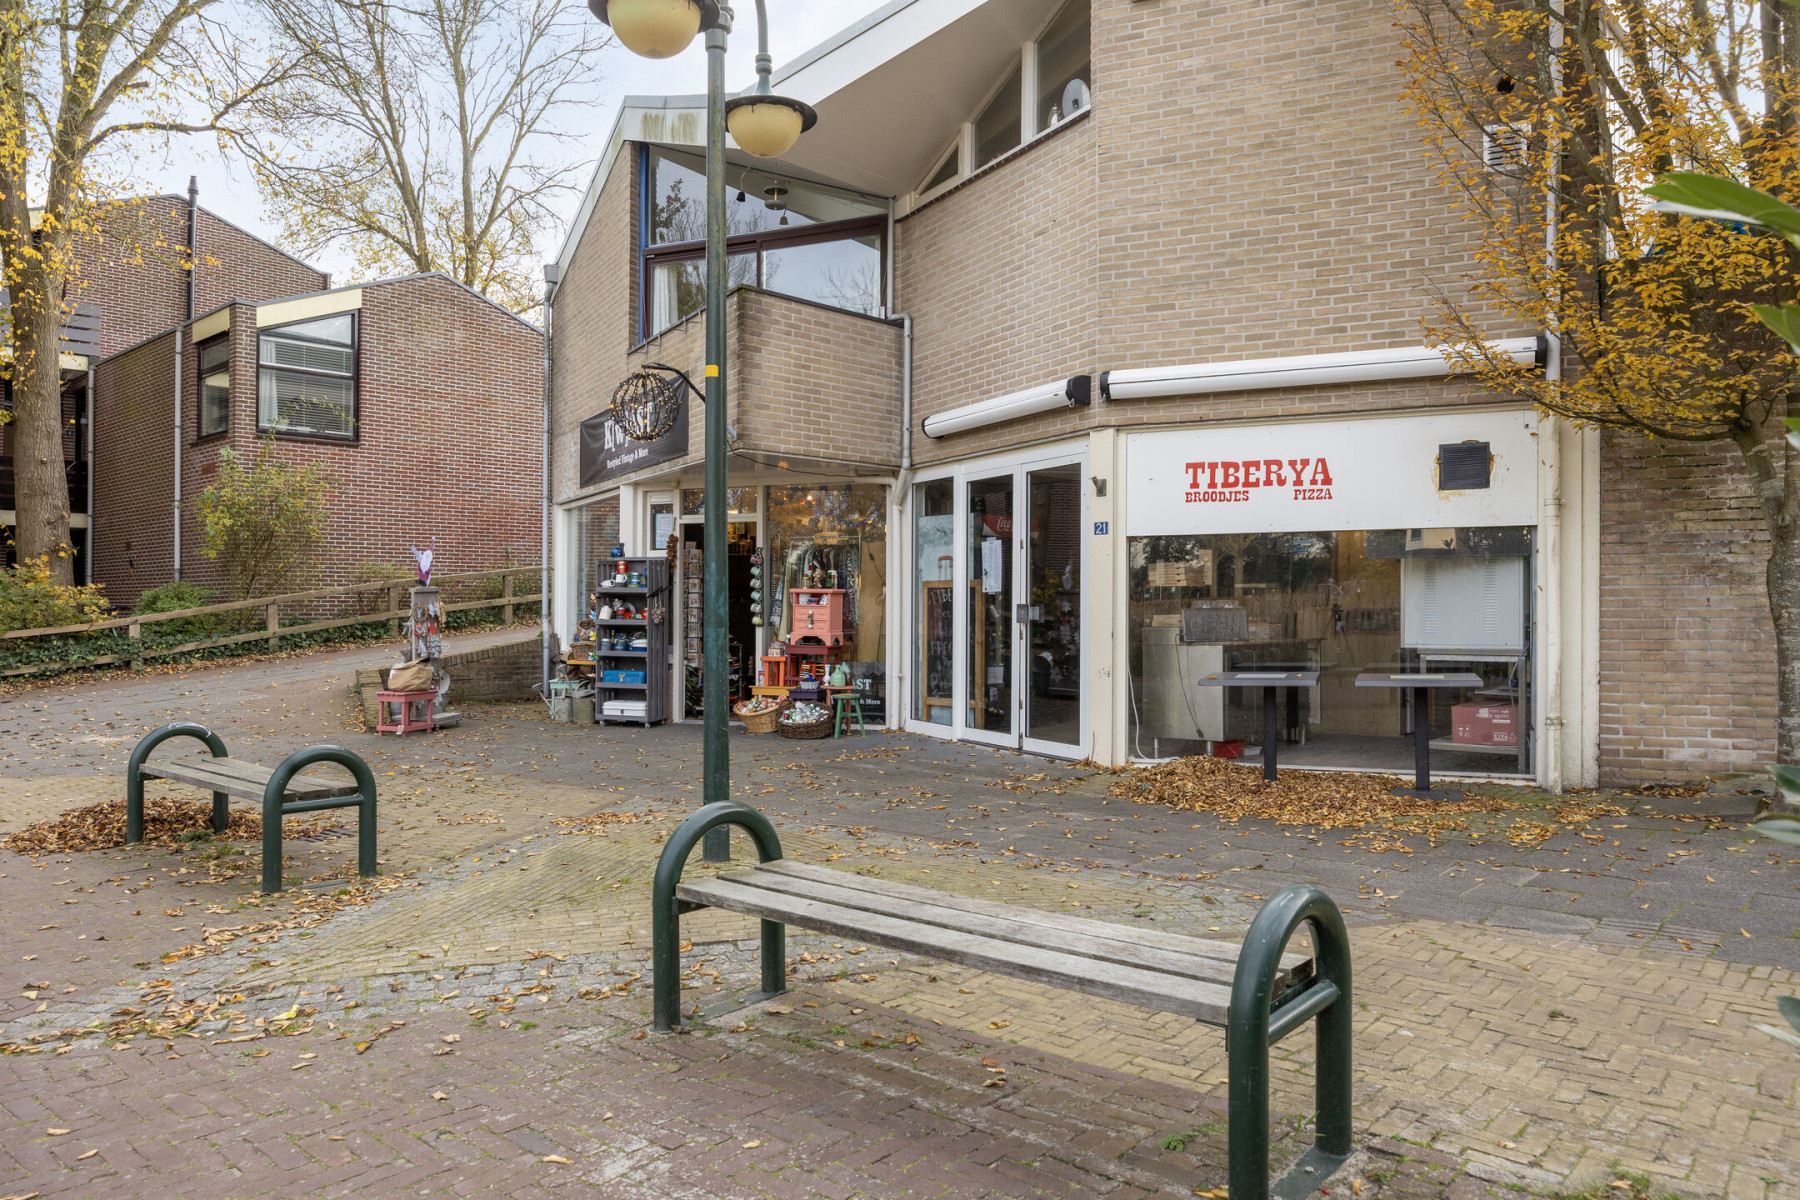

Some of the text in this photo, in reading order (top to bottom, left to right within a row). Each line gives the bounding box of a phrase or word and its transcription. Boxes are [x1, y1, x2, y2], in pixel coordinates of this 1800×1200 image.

[638, 448, 649, 458] More
[1185, 458, 1333, 489] TIBERYA
[1185, 488, 1333, 503] BROODJES PIZZA
[1096, 522, 1106, 534] 21
